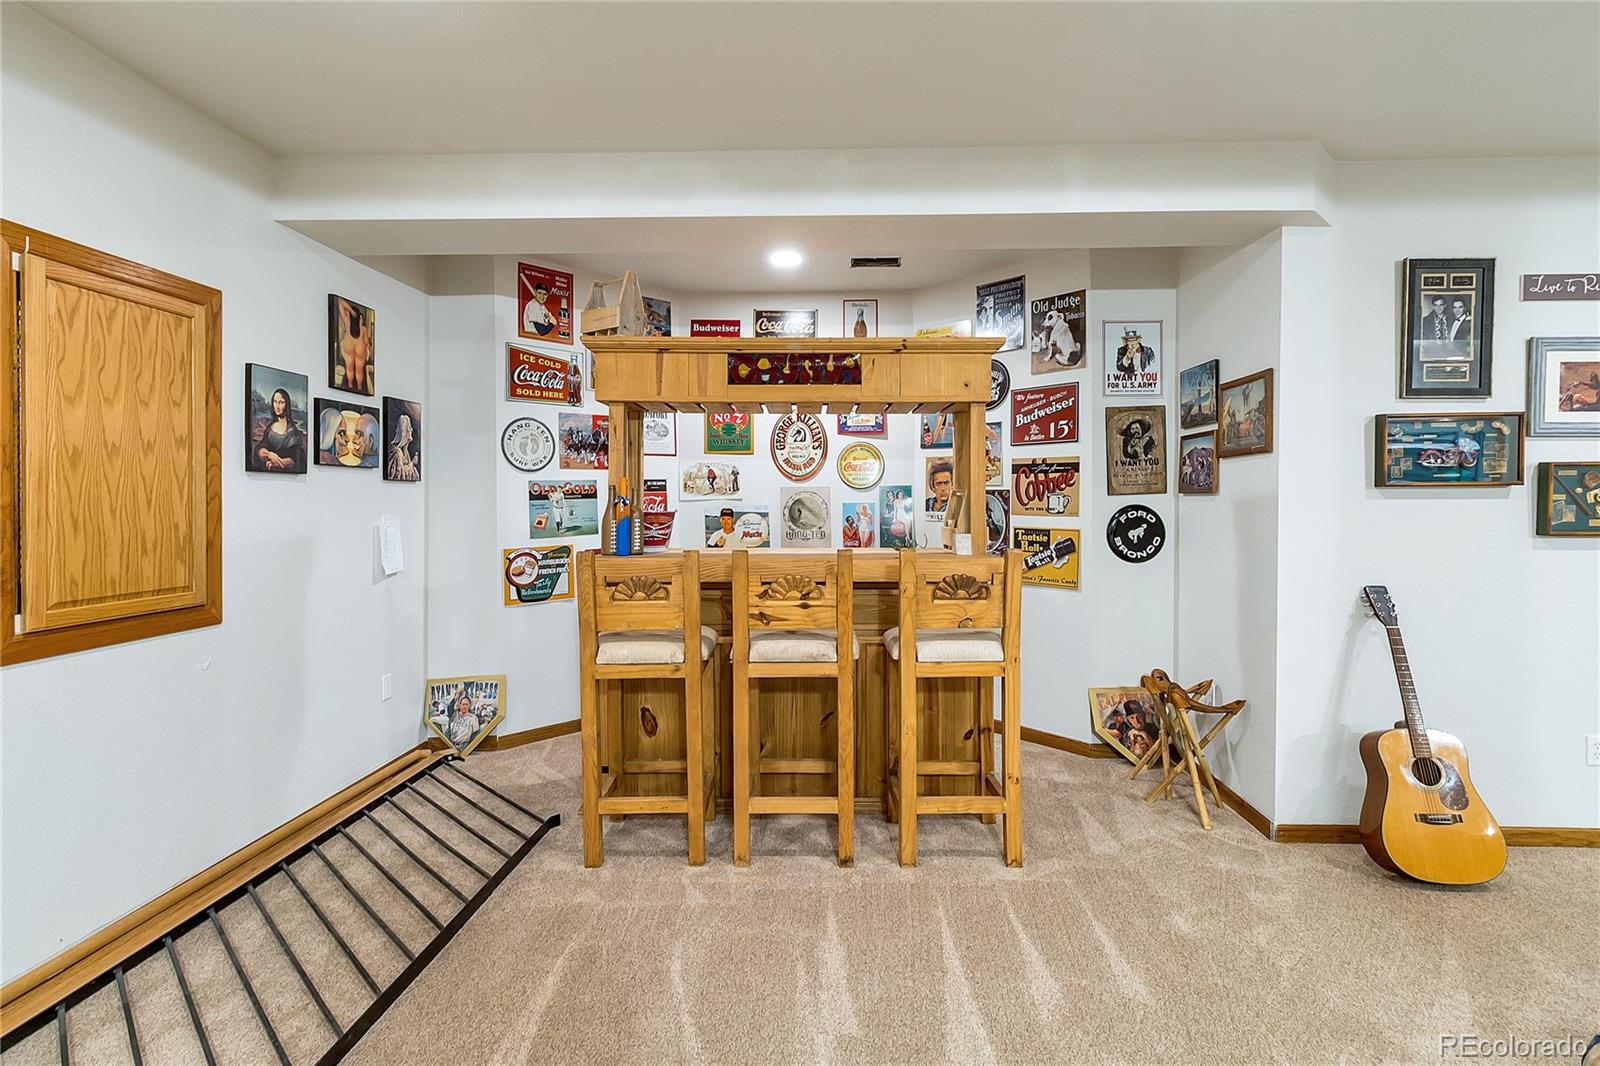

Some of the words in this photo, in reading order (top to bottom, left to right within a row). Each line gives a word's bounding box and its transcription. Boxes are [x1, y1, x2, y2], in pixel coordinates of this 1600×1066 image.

[1529, 275, 1563, 294] Live
[1032, 301, 1049, 314] Old
[1051, 296, 1081, 310] Judge
[692, 323, 740, 333] Budweiser
[519, 353, 536, 363] ICE
[538, 359, 562, 369] COLD
[1107, 373, 1110, 382] I
[1113, 373, 1138, 382] WANT
[1140, 372, 1158, 382] YOU
[516, 388, 541, 397] SOLD
[542, 391, 564, 399] HERE
[1024, 393, 1045, 404] feature
[732, 413, 744, 424] 7
[1015, 397, 1075, 427] Budweiser
[507, 422, 531, 441] HANG
[536, 425, 550, 443] TEN
[776, 415, 796, 450] GEORGE
[509, 452, 529, 467] SURF
[531, 455, 548, 468] WAX
[802, 457, 816, 471] RED
[1120, 459, 1142, 467] WANT
[1144, 457, 1160, 466] YOU
[529, 482, 558, 496] OLD
[563, 482, 597, 495] GOLD
[1120, 510, 1156, 523] FORD
[1016, 530, 1048, 542] Tootsie
[1114, 536, 1161, 558] BRONCO
[1027, 549, 1052, 567] Tootsie
